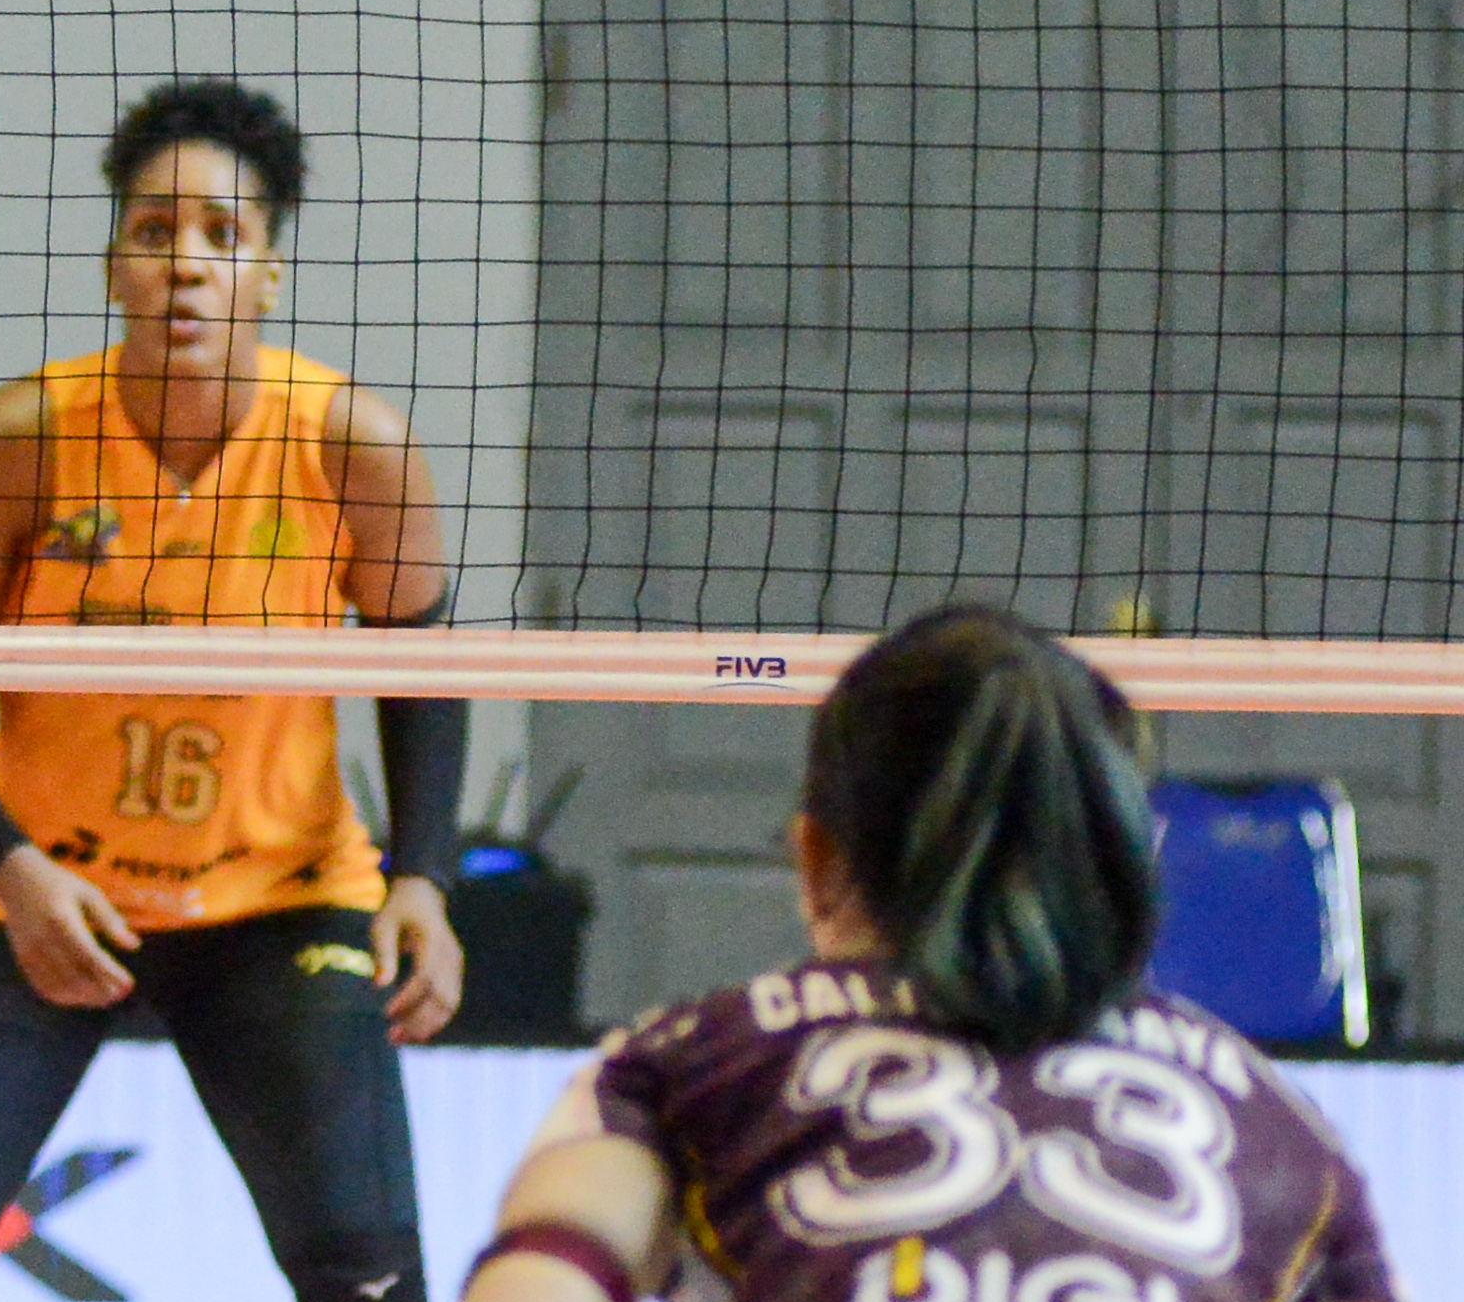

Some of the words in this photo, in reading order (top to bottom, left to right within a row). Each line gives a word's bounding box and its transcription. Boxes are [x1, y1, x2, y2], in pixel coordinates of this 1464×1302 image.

[716, 656, 787, 679] FIVB
[111, 712, 225, 826] 16
[765, 1025, 1244, 1278] 33
